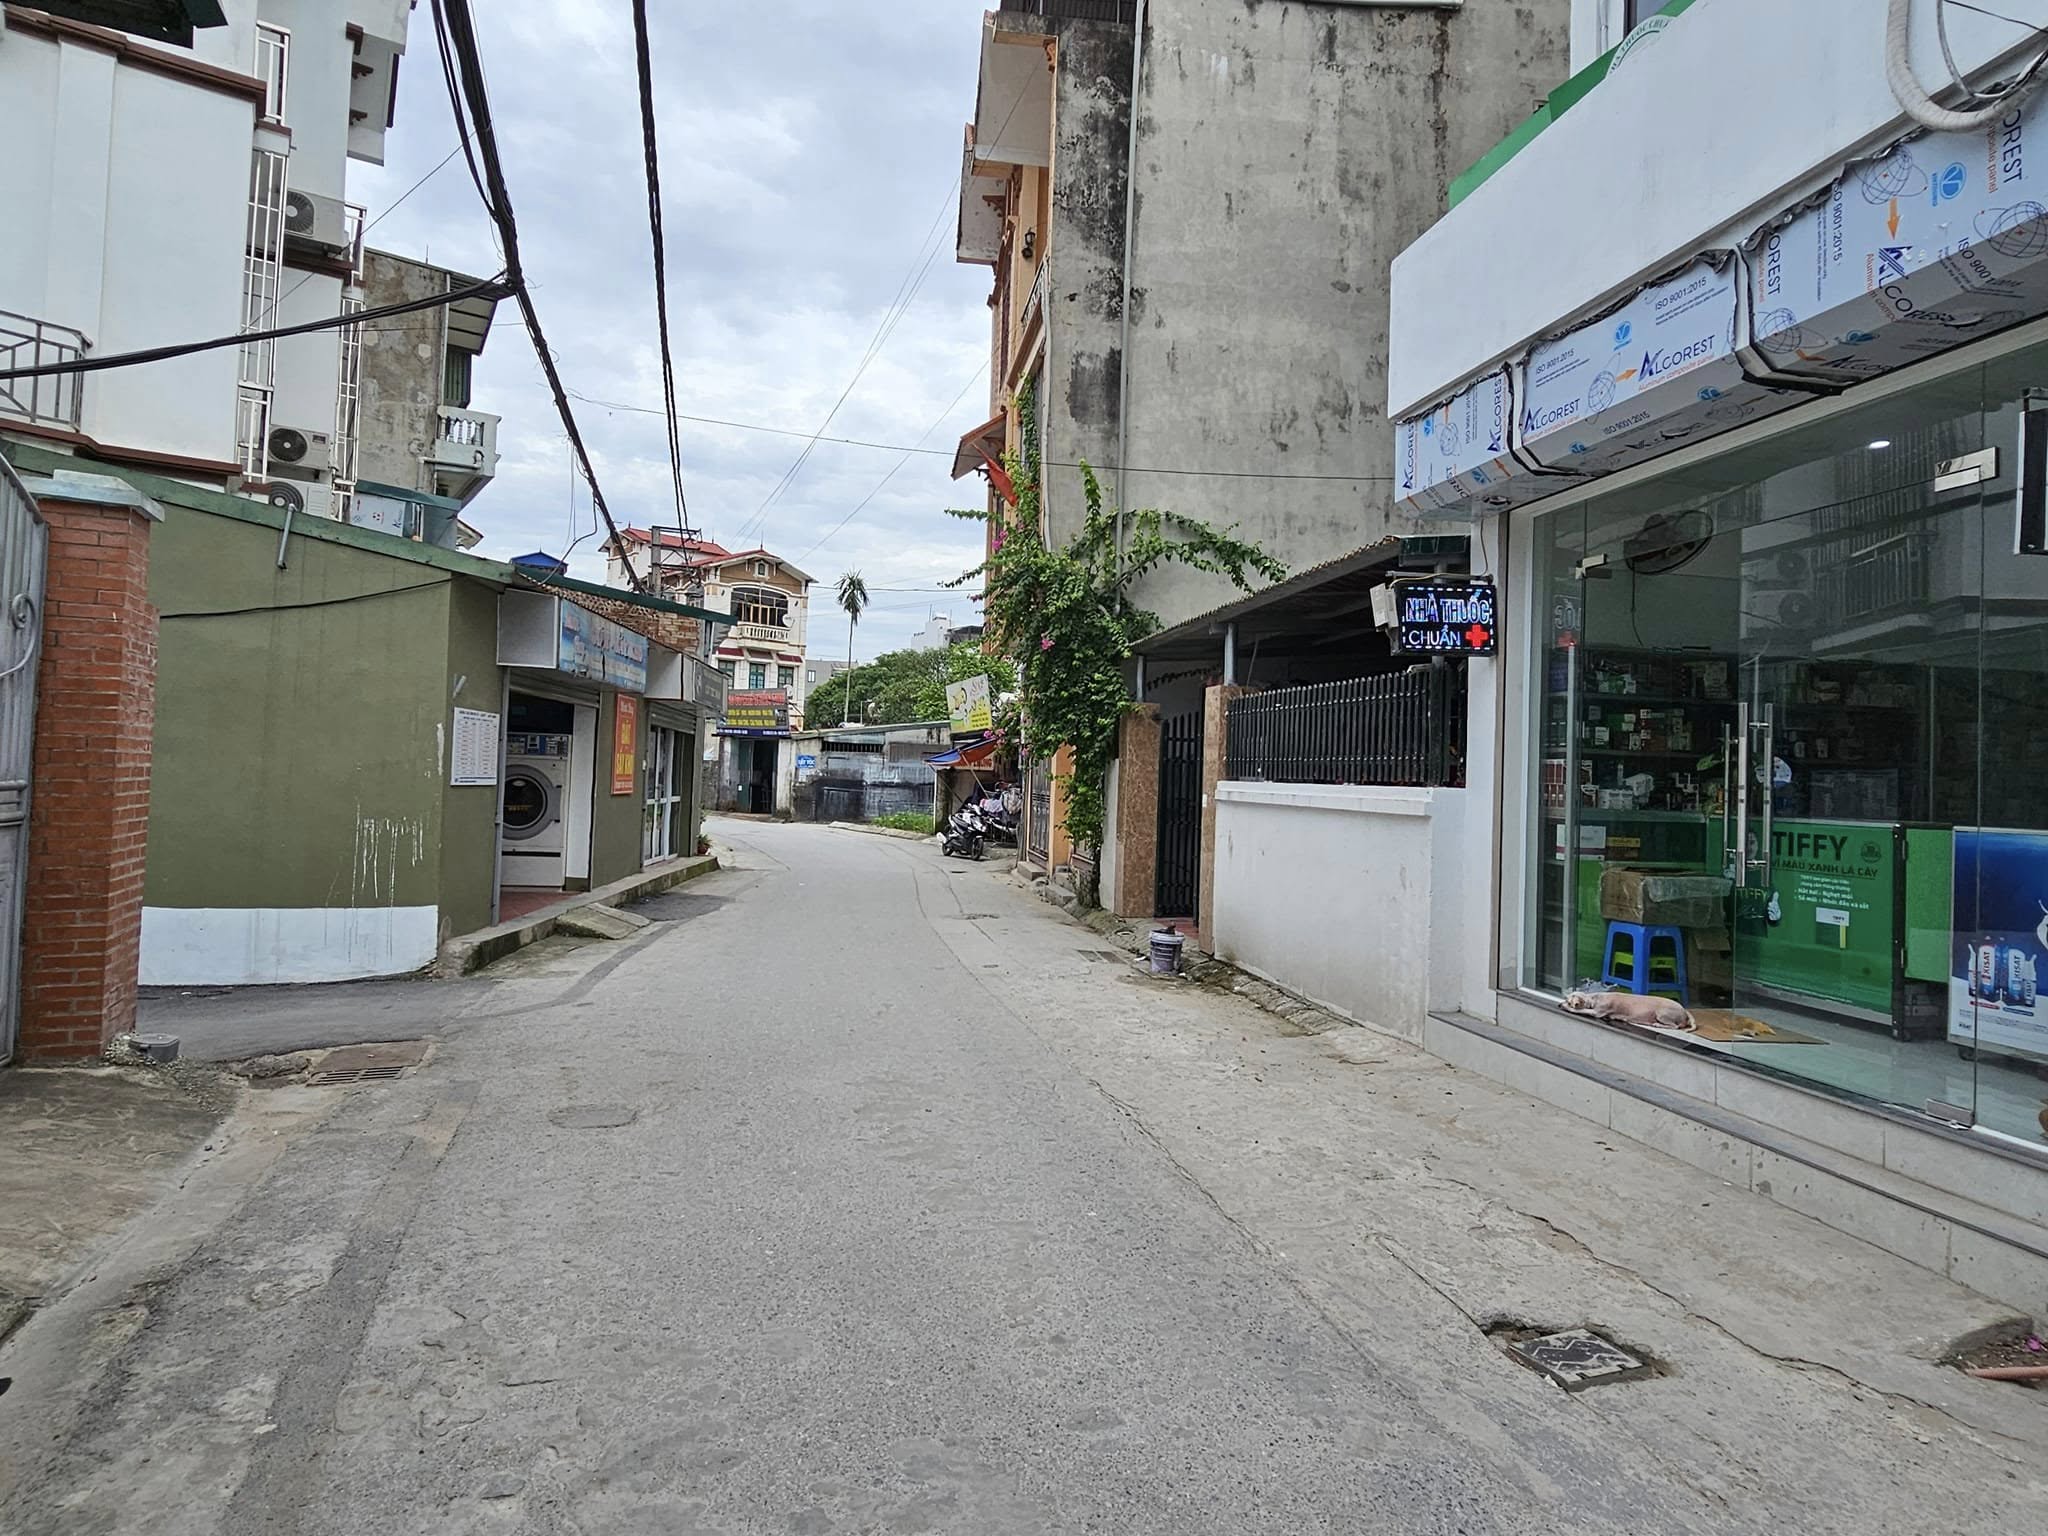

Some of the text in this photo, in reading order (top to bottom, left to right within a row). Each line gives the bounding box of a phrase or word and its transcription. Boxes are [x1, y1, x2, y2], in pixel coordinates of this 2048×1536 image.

[1655, 298, 1669, 311] ISO
[1638, 334, 1715, 381] ALCOREST
[1523, 398, 1580, 433] ALCOREST
[1406, 590, 1490, 624] NHÀ THUỐC
[1408, 624, 1461, 646] CHUẨN
[1773, 831, 1848, 862] TIFFY
